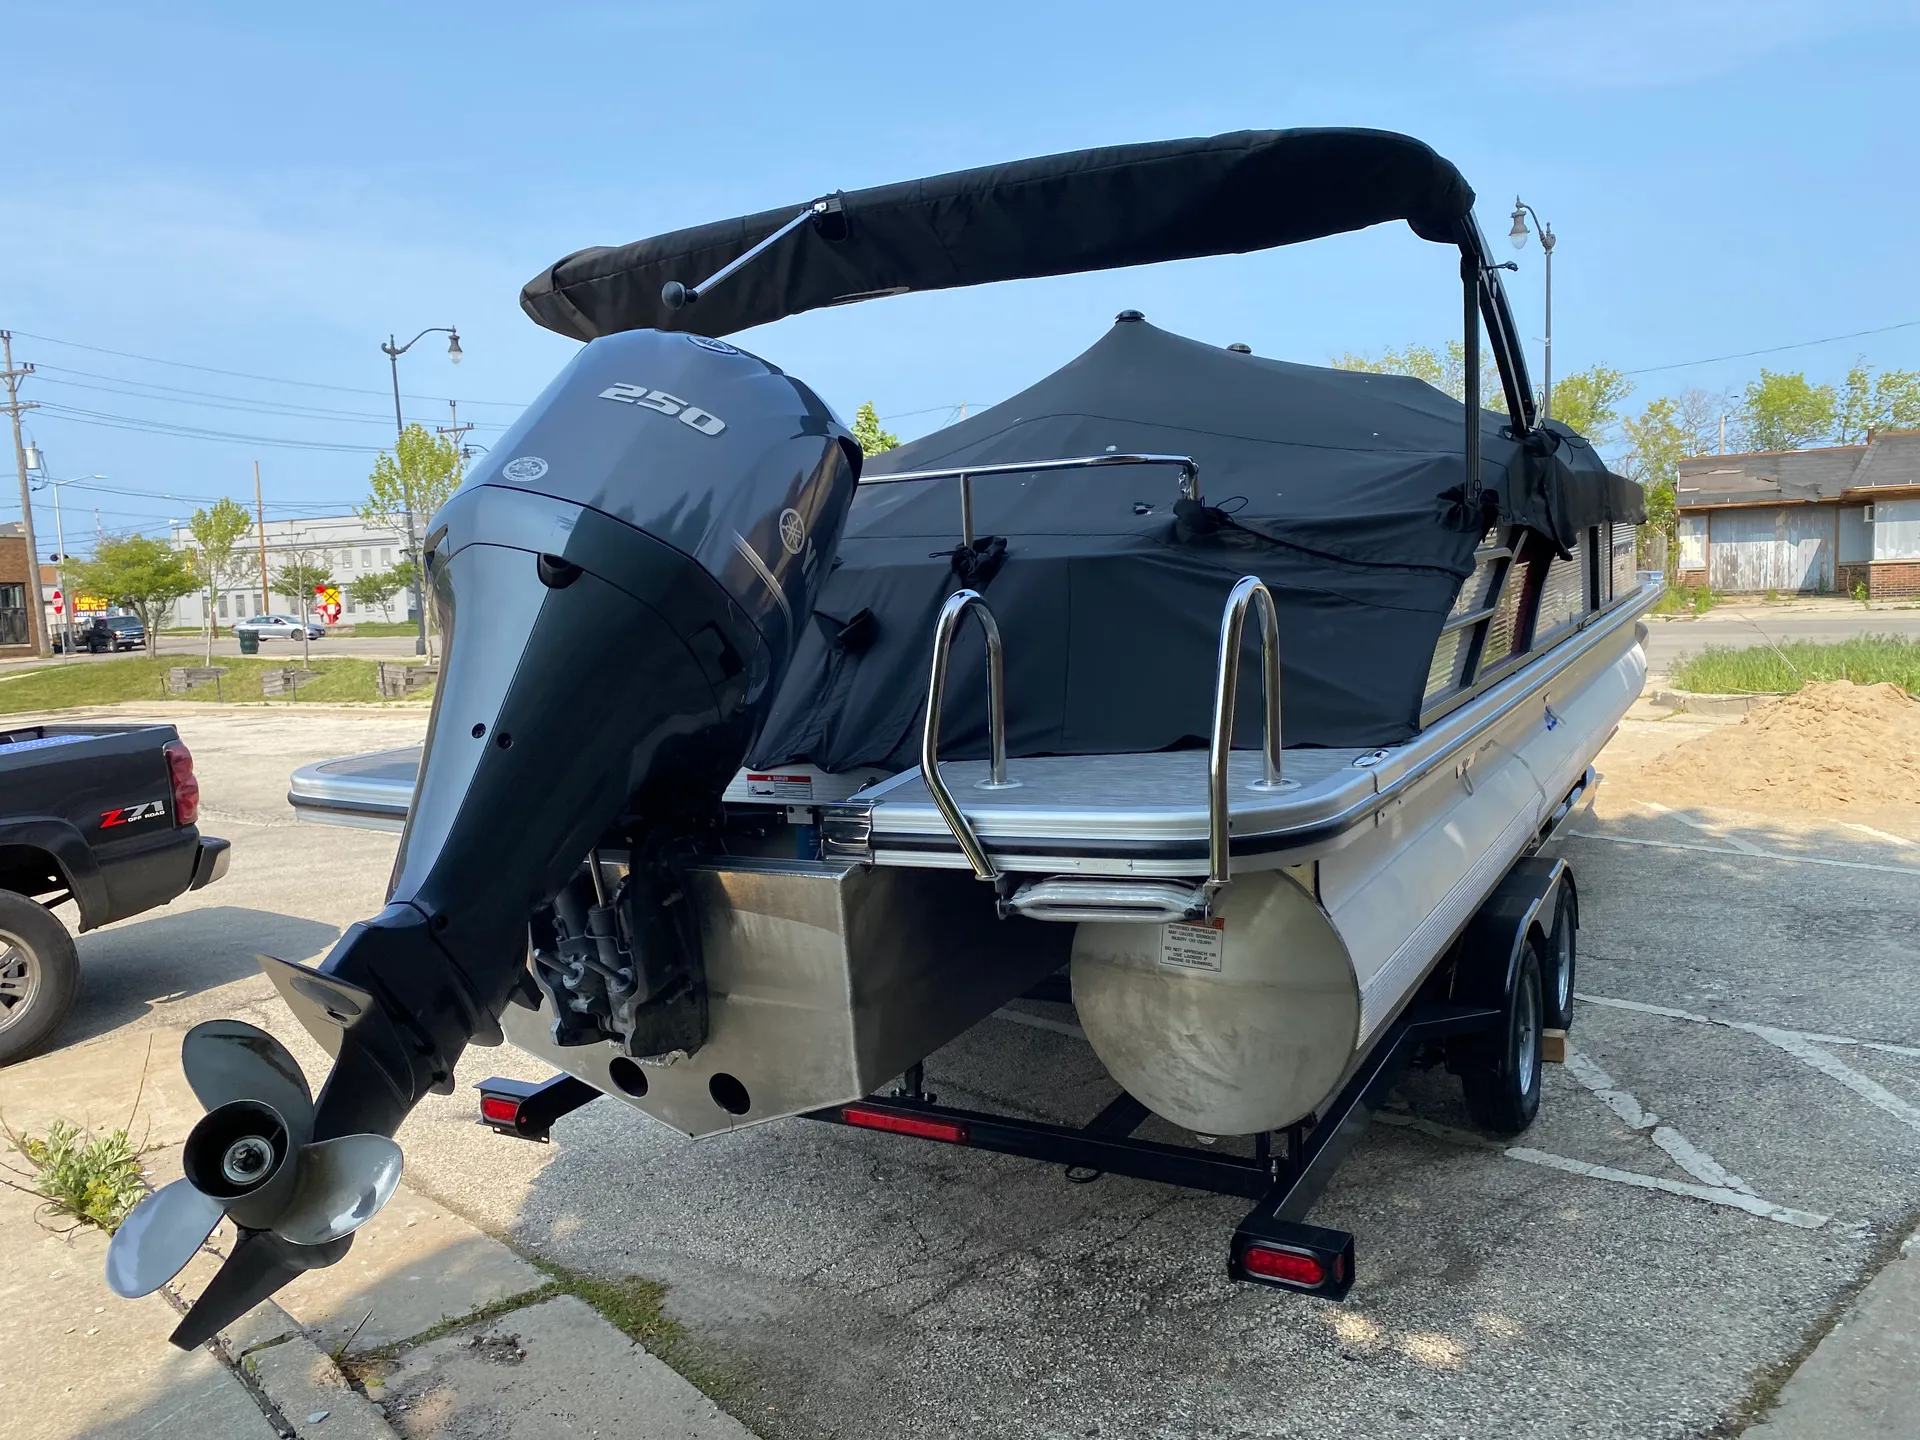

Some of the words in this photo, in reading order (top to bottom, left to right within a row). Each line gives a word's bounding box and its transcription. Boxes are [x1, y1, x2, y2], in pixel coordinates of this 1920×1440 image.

[598, 382, 726, 436] 250
[101, 800, 164, 828] Z71
[144, 811, 165, 819] ROAD
